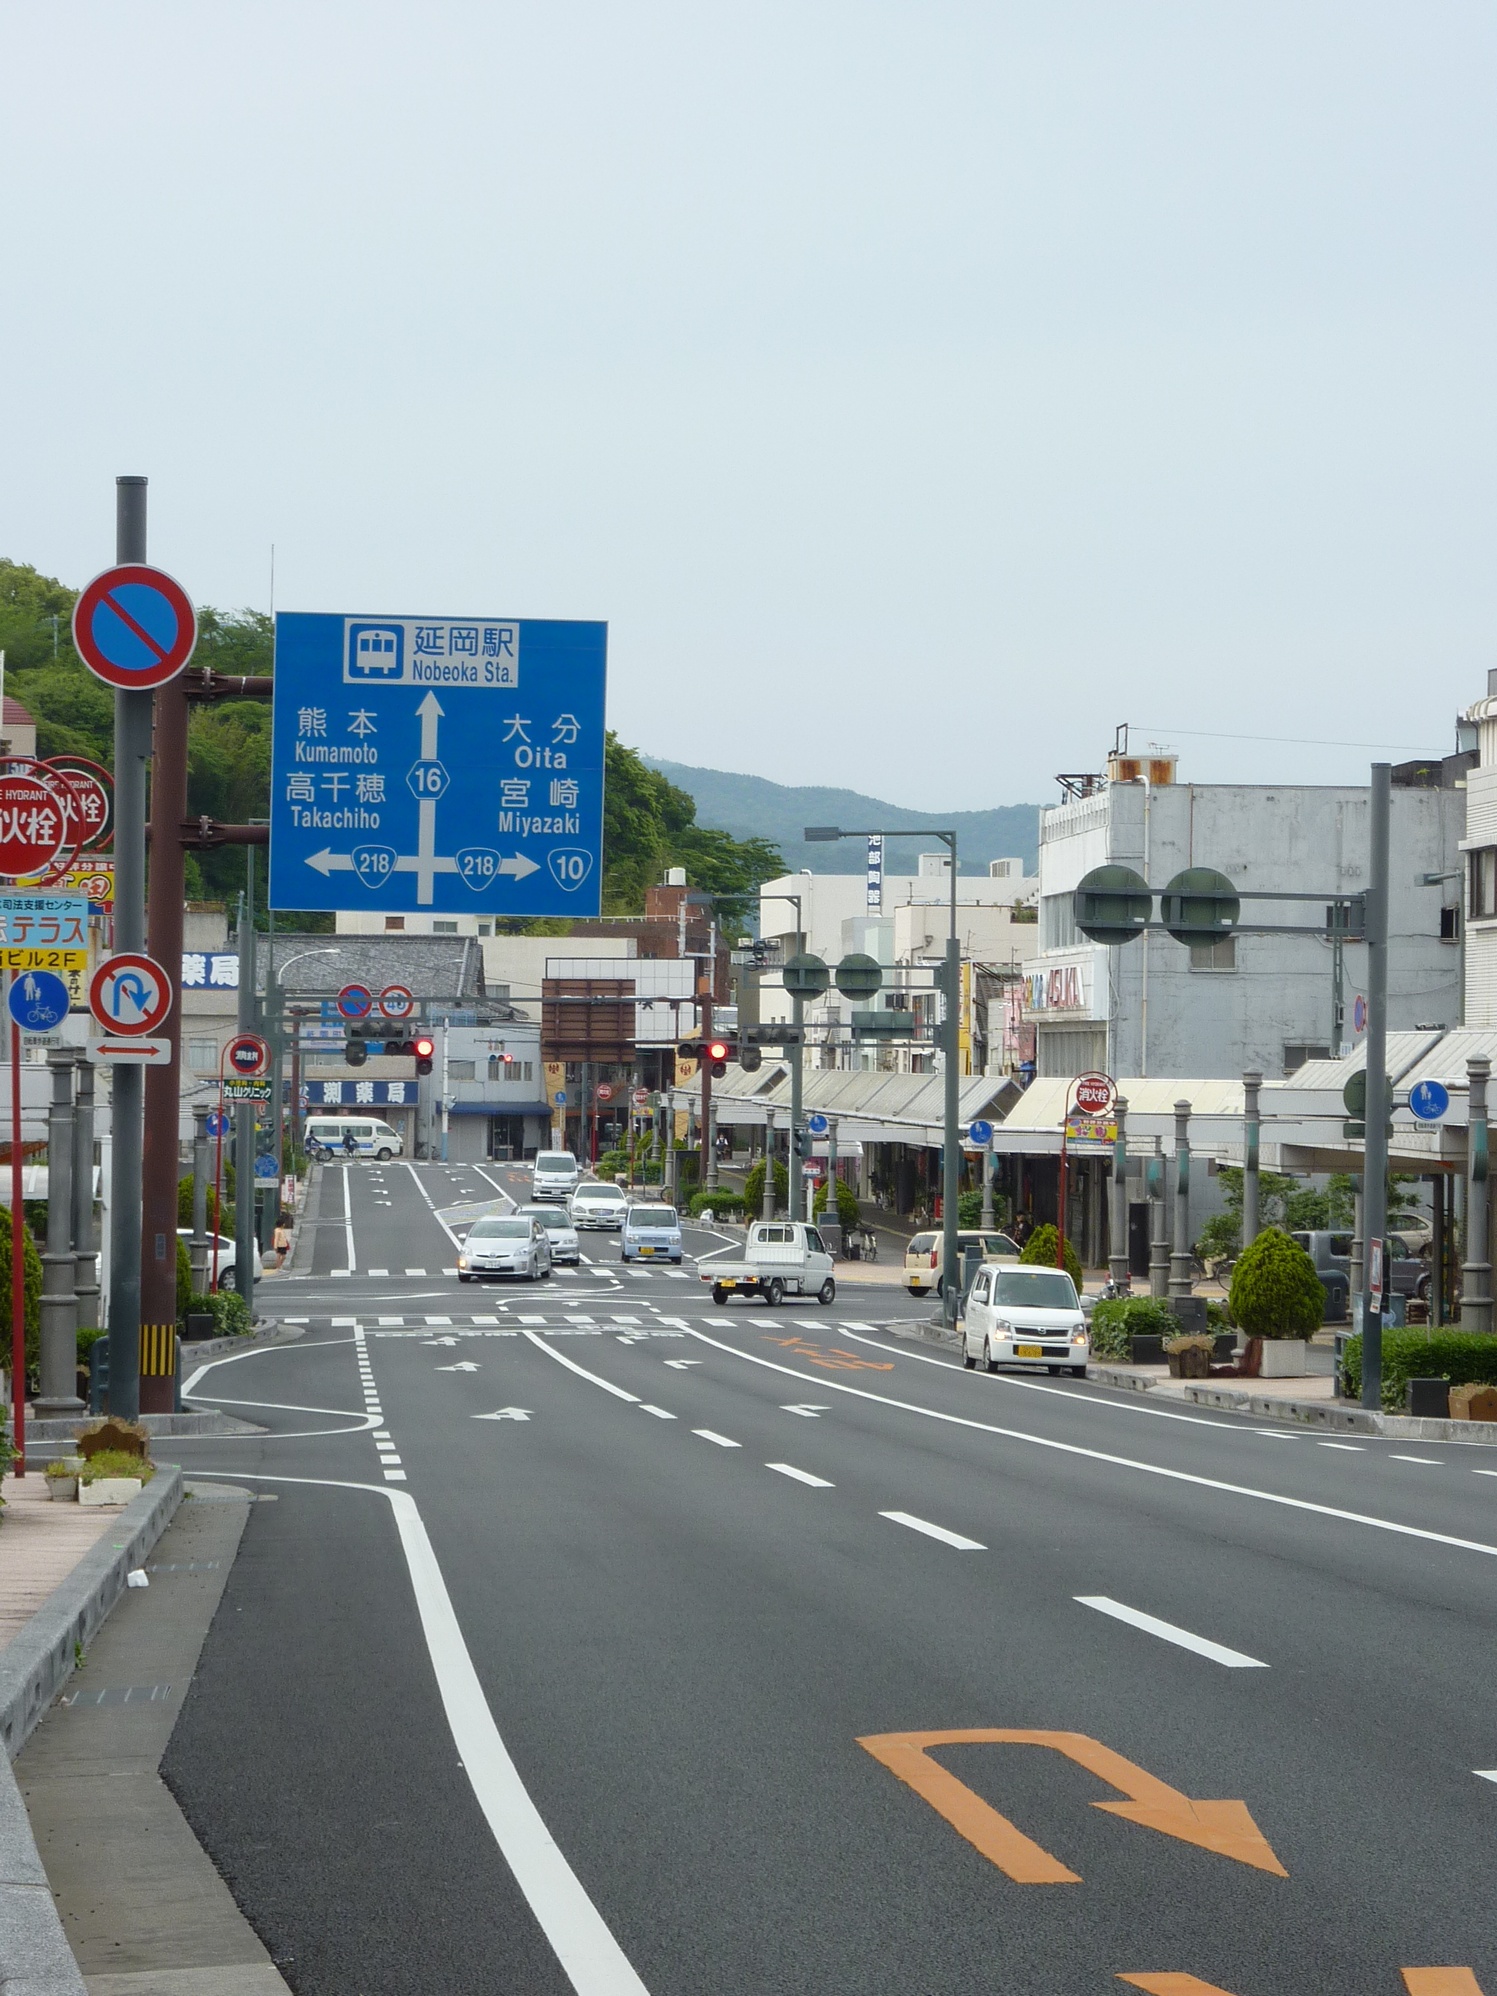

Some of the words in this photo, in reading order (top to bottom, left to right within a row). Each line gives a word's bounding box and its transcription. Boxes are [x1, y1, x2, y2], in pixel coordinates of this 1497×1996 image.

[413, 626, 515, 658] 延岡駅
[413, 660, 478, 682] Nobeoka
[484, 662, 514, 683] Sta.
[297, 706, 378, 739] 熊本
[502, 713, 581, 744] 大分
[295, 741, 378, 764] Kumamoto
[514, 746, 567, 769] Oita
[286, 771, 386, 803] 高千穂
[415, 768, 441, 792] 16
[5, 790, 48, 801] HYDRANT
[500, 777, 580, 809] 宮崎
[59, 794, 102, 823] 火栓
[291, 805, 380, 829] Takachiho
[0, 807, 57, 845] 火栓
[499, 811, 580, 837] Miyazaki
[360, 853, 389, 872] 218
[464, 856, 494, 875] 218
[556, 857, 583, 880] 10
[0, 899, 82, 911] 司法支援センター
[0, 950, 76, 967] ビル2F
[223, 1086, 272, 1099] 丸山クリニック
[1079, 1088, 1109, 1103] 消火栓
